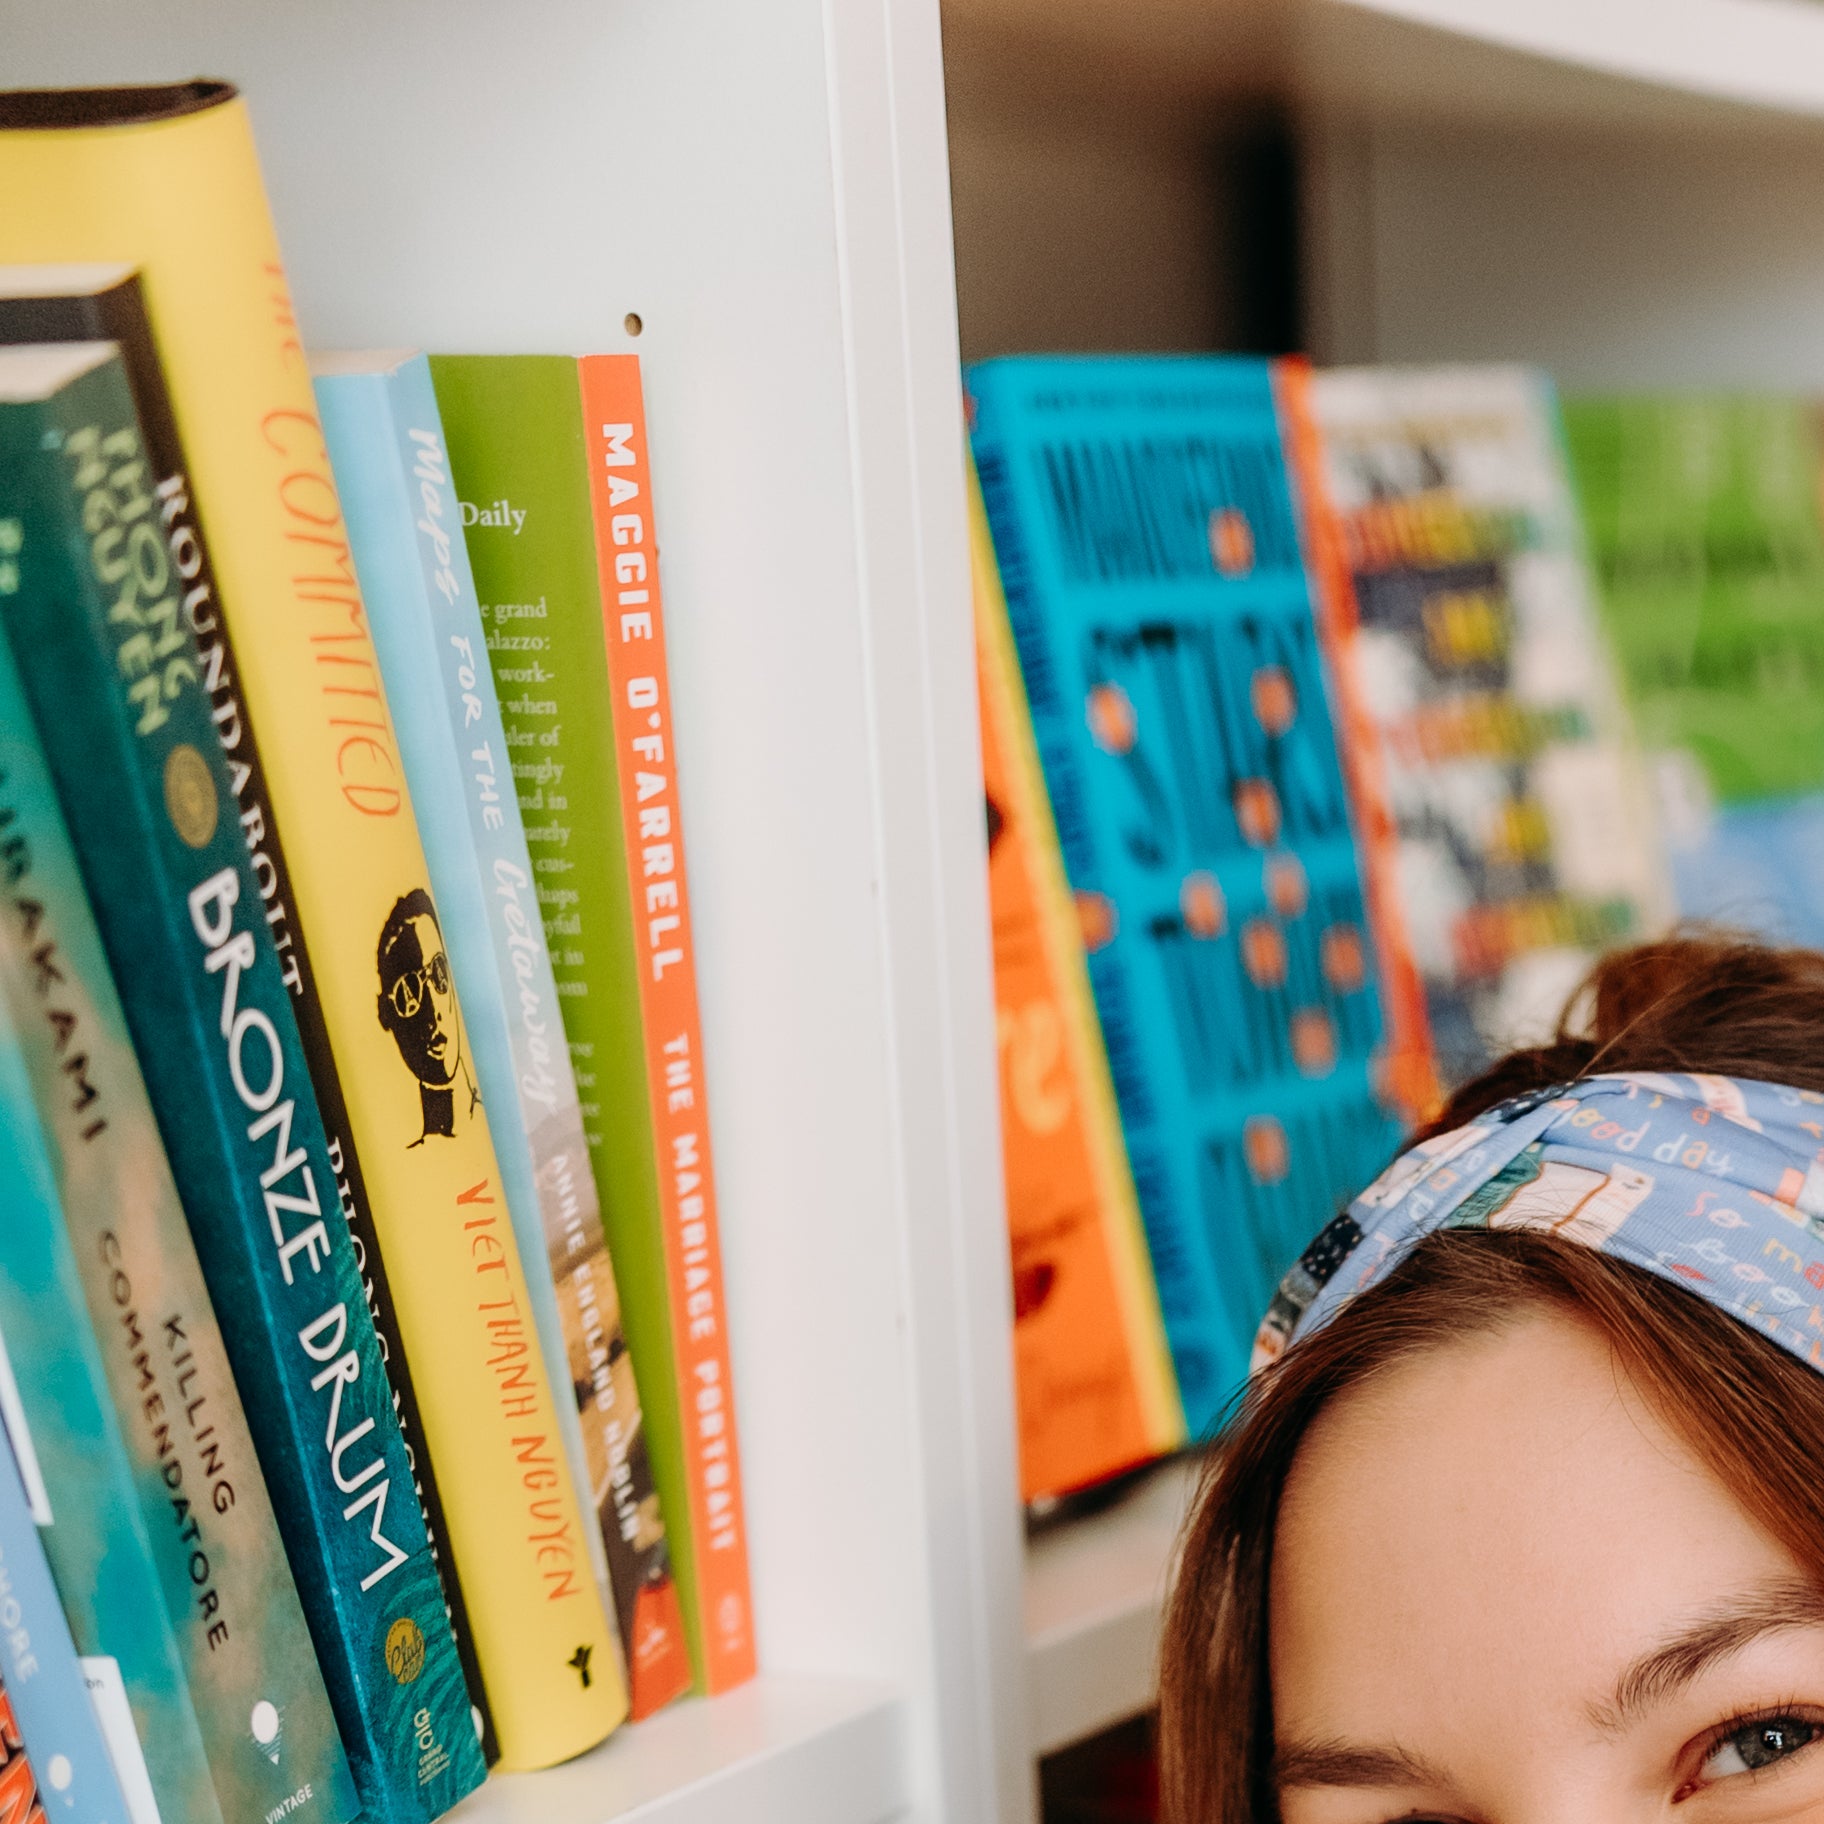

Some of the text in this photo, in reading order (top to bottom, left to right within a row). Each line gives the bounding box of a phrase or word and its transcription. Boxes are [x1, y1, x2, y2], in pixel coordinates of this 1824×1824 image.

[65, 425, 171, 736] NGUYEN
[102, 426, 197, 699] PHONG
[261, 409, 401, 818] COMMITTED
[458, 500, 527, 535] Daily
[494, 596, 547, 624] grand
[485, 629, 551, 651] alazzo:
[508, 694, 558, 715] when
[602, 423, 687, 982] MAGGIE O'FARRELL
[471, 741, 505, 831] THE
[662, 1032, 694, 1114] THE
[1651, 1132, 1735, 1176] day
[187, 866, 410, 1593] BRONZE DRUM
[551, 1153, 586, 1256] ANNIE
[672, 1132, 717, 1342] MARRIAGE
[98, 1229, 231, 1654] COMMENDATORE
[162, 1313, 236, 1516] KILLING
[456, 1178, 583, 1602] VIET THANH NGUYEN
[693, 1358, 738, 1551] PORTRAIT
